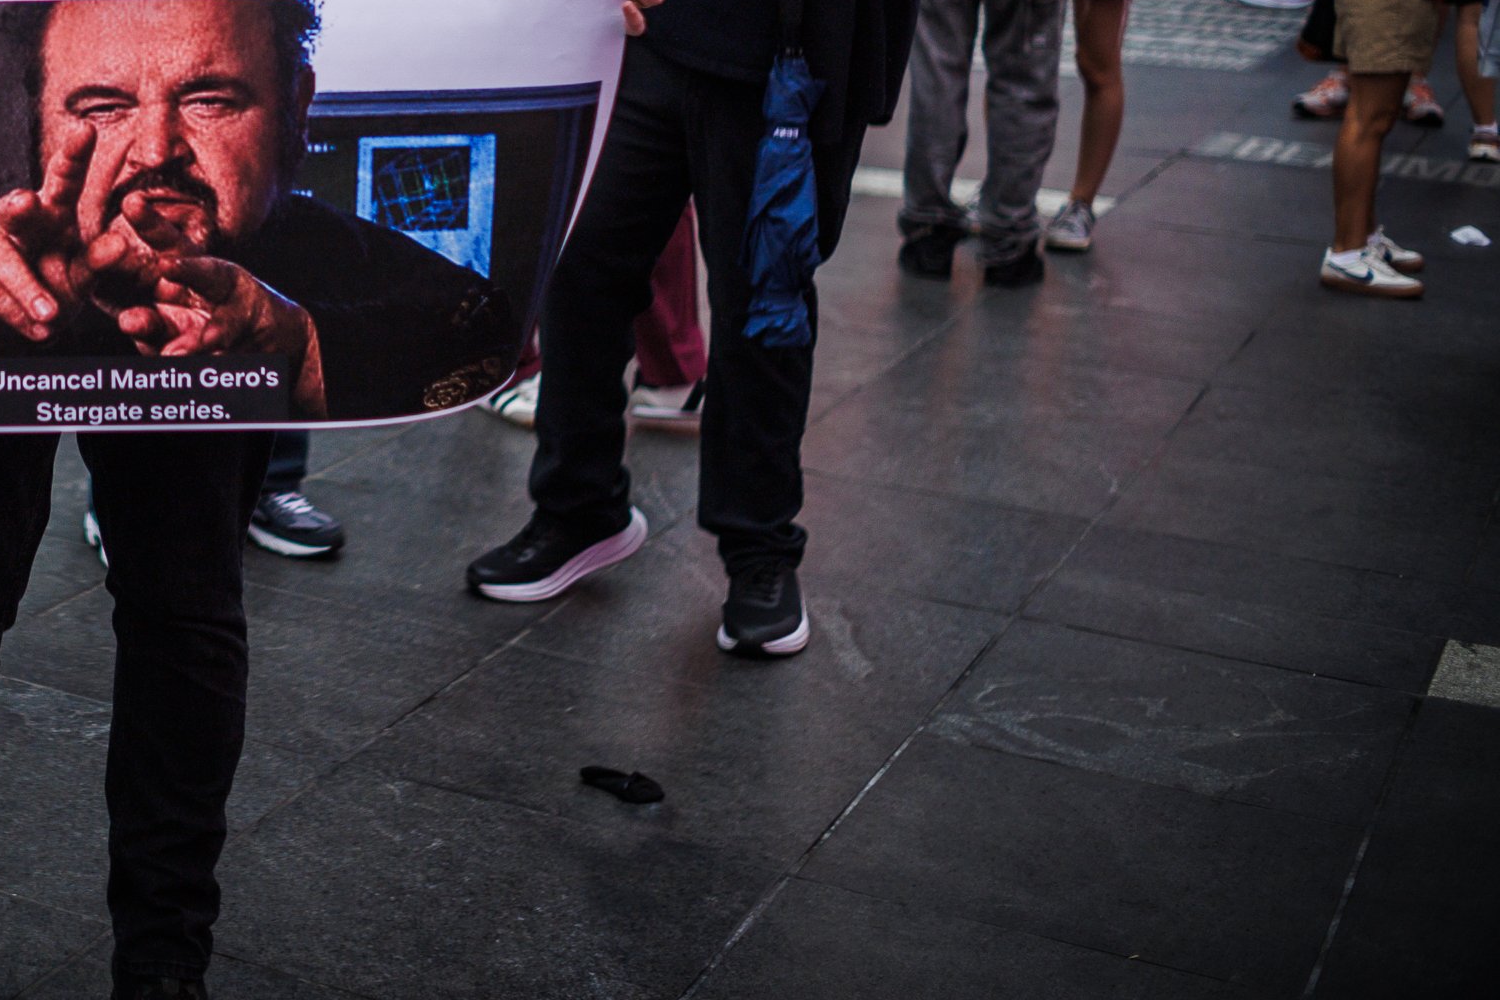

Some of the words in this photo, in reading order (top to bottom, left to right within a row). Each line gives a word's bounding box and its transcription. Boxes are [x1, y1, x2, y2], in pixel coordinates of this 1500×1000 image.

[110, 367, 192, 390] Martin
[199, 366, 280, 389] Gero's
[36, 401, 143, 425] Stargate
[150, 399, 231, 420] series.
